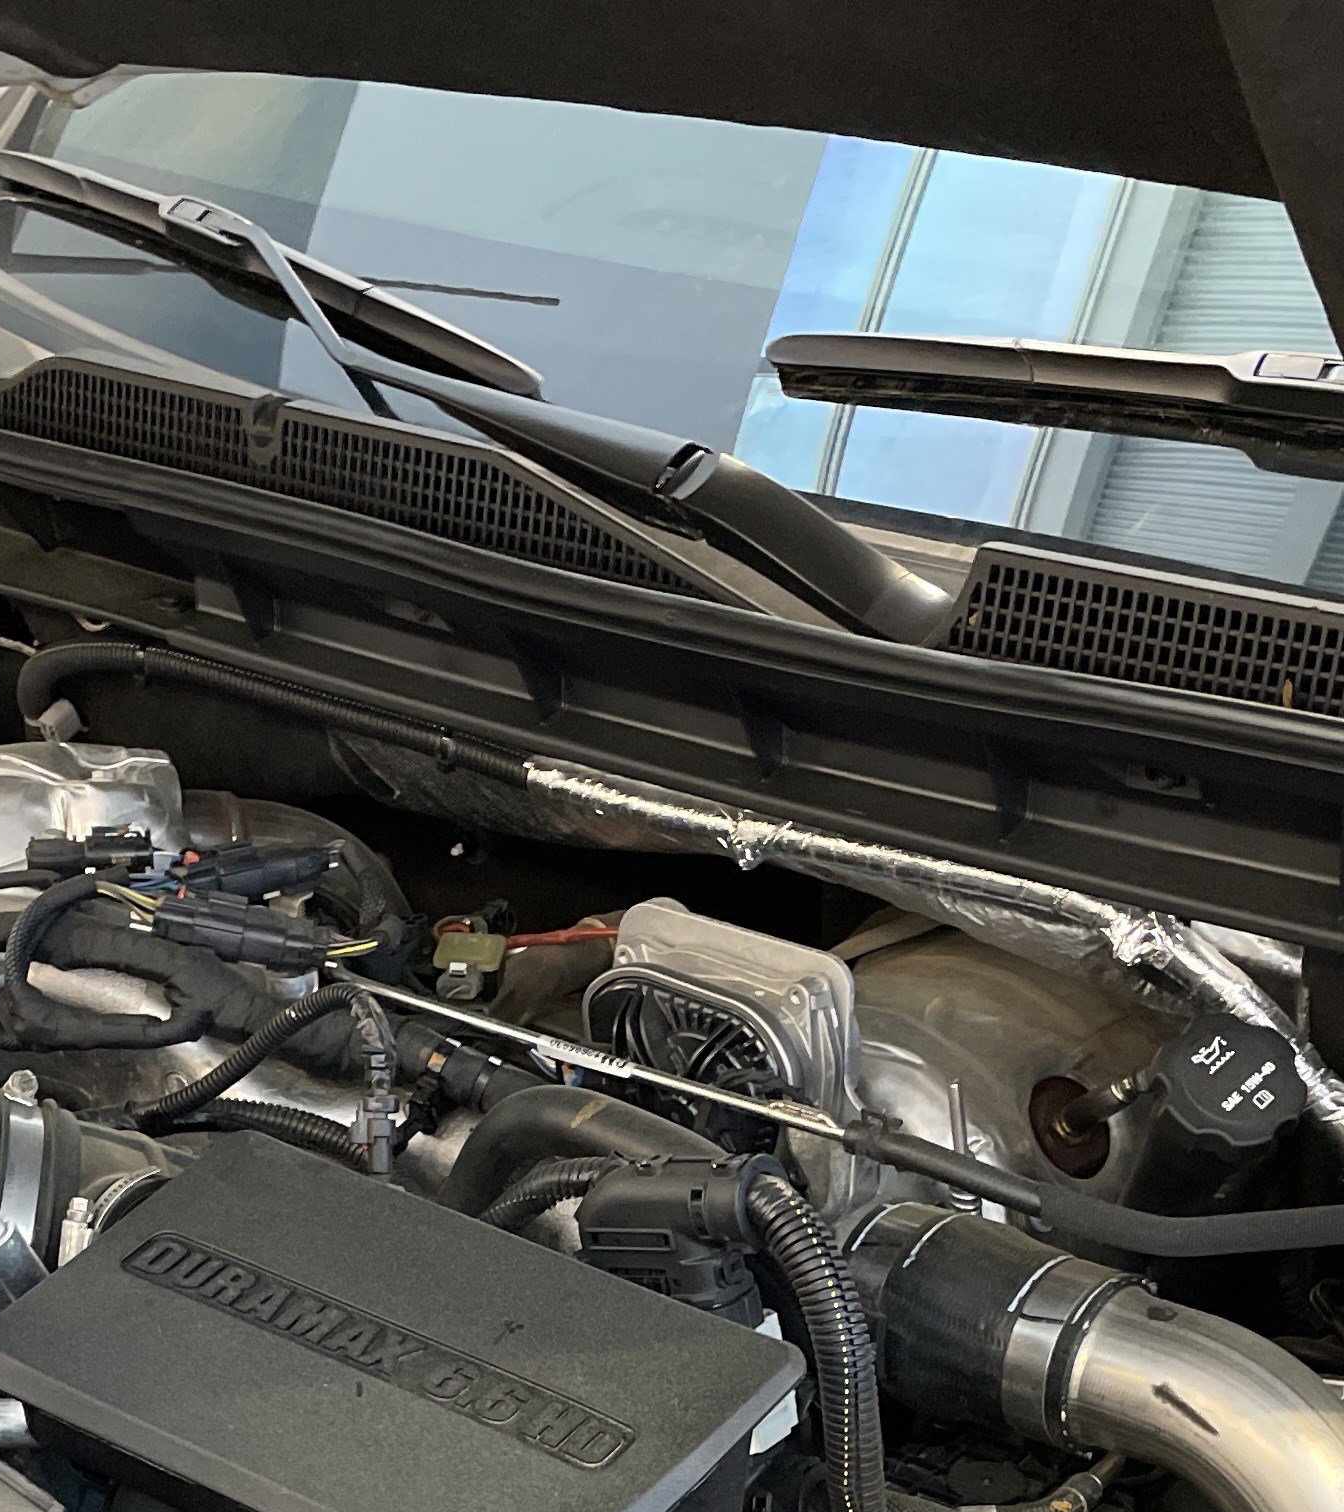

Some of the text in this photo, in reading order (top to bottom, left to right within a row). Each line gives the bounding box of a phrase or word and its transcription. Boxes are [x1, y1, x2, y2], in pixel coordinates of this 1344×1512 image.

[1221, 1061, 1276, 1112] SAE 15W-40
[130, 1240, 626, 1468] DURAMAX 6.6 HD
